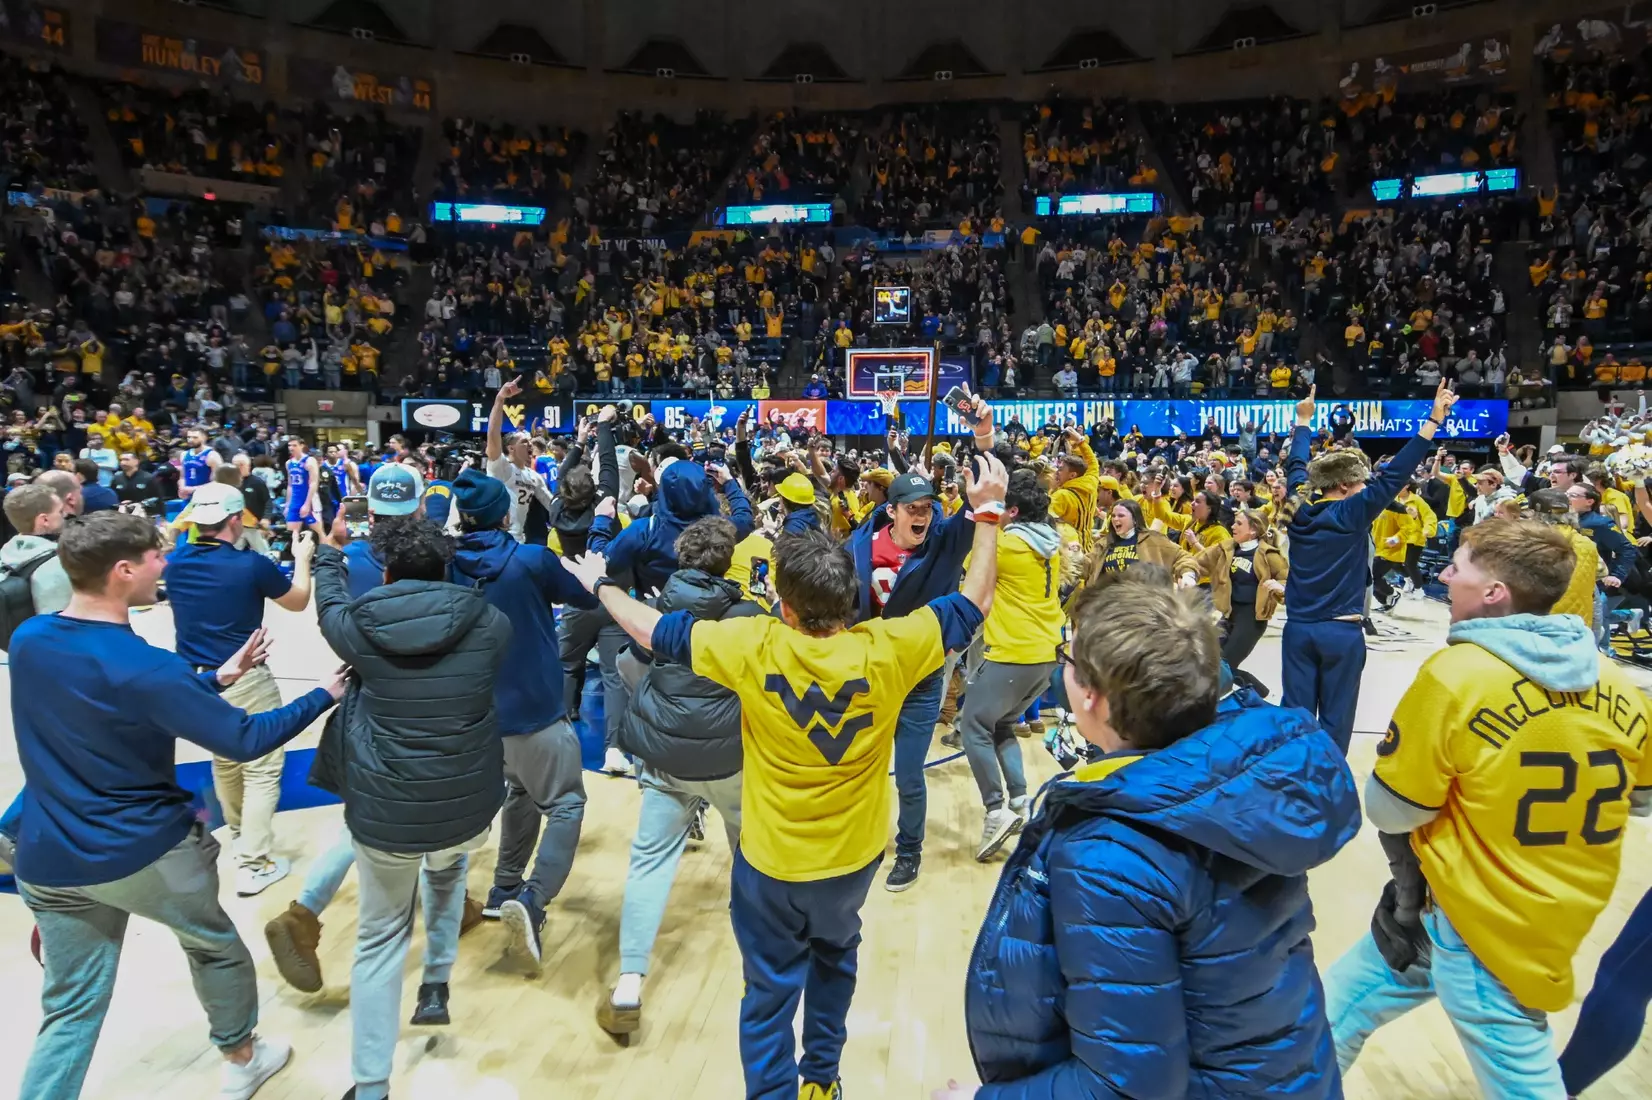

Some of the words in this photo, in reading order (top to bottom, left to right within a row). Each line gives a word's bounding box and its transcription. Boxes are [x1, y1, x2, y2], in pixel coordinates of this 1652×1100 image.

[353, 84, 393, 105] WEST
[544, 406, 560, 428] 91
[664, 407, 685, 429] 85
[1083, 400, 1115, 432] WIN
[1348, 400, 1382, 431] WIN
[1445, 419, 1479, 433] BALL
[1105, 551, 1140, 563] VIRGINIA
[1513, 749, 1628, 846] 22
